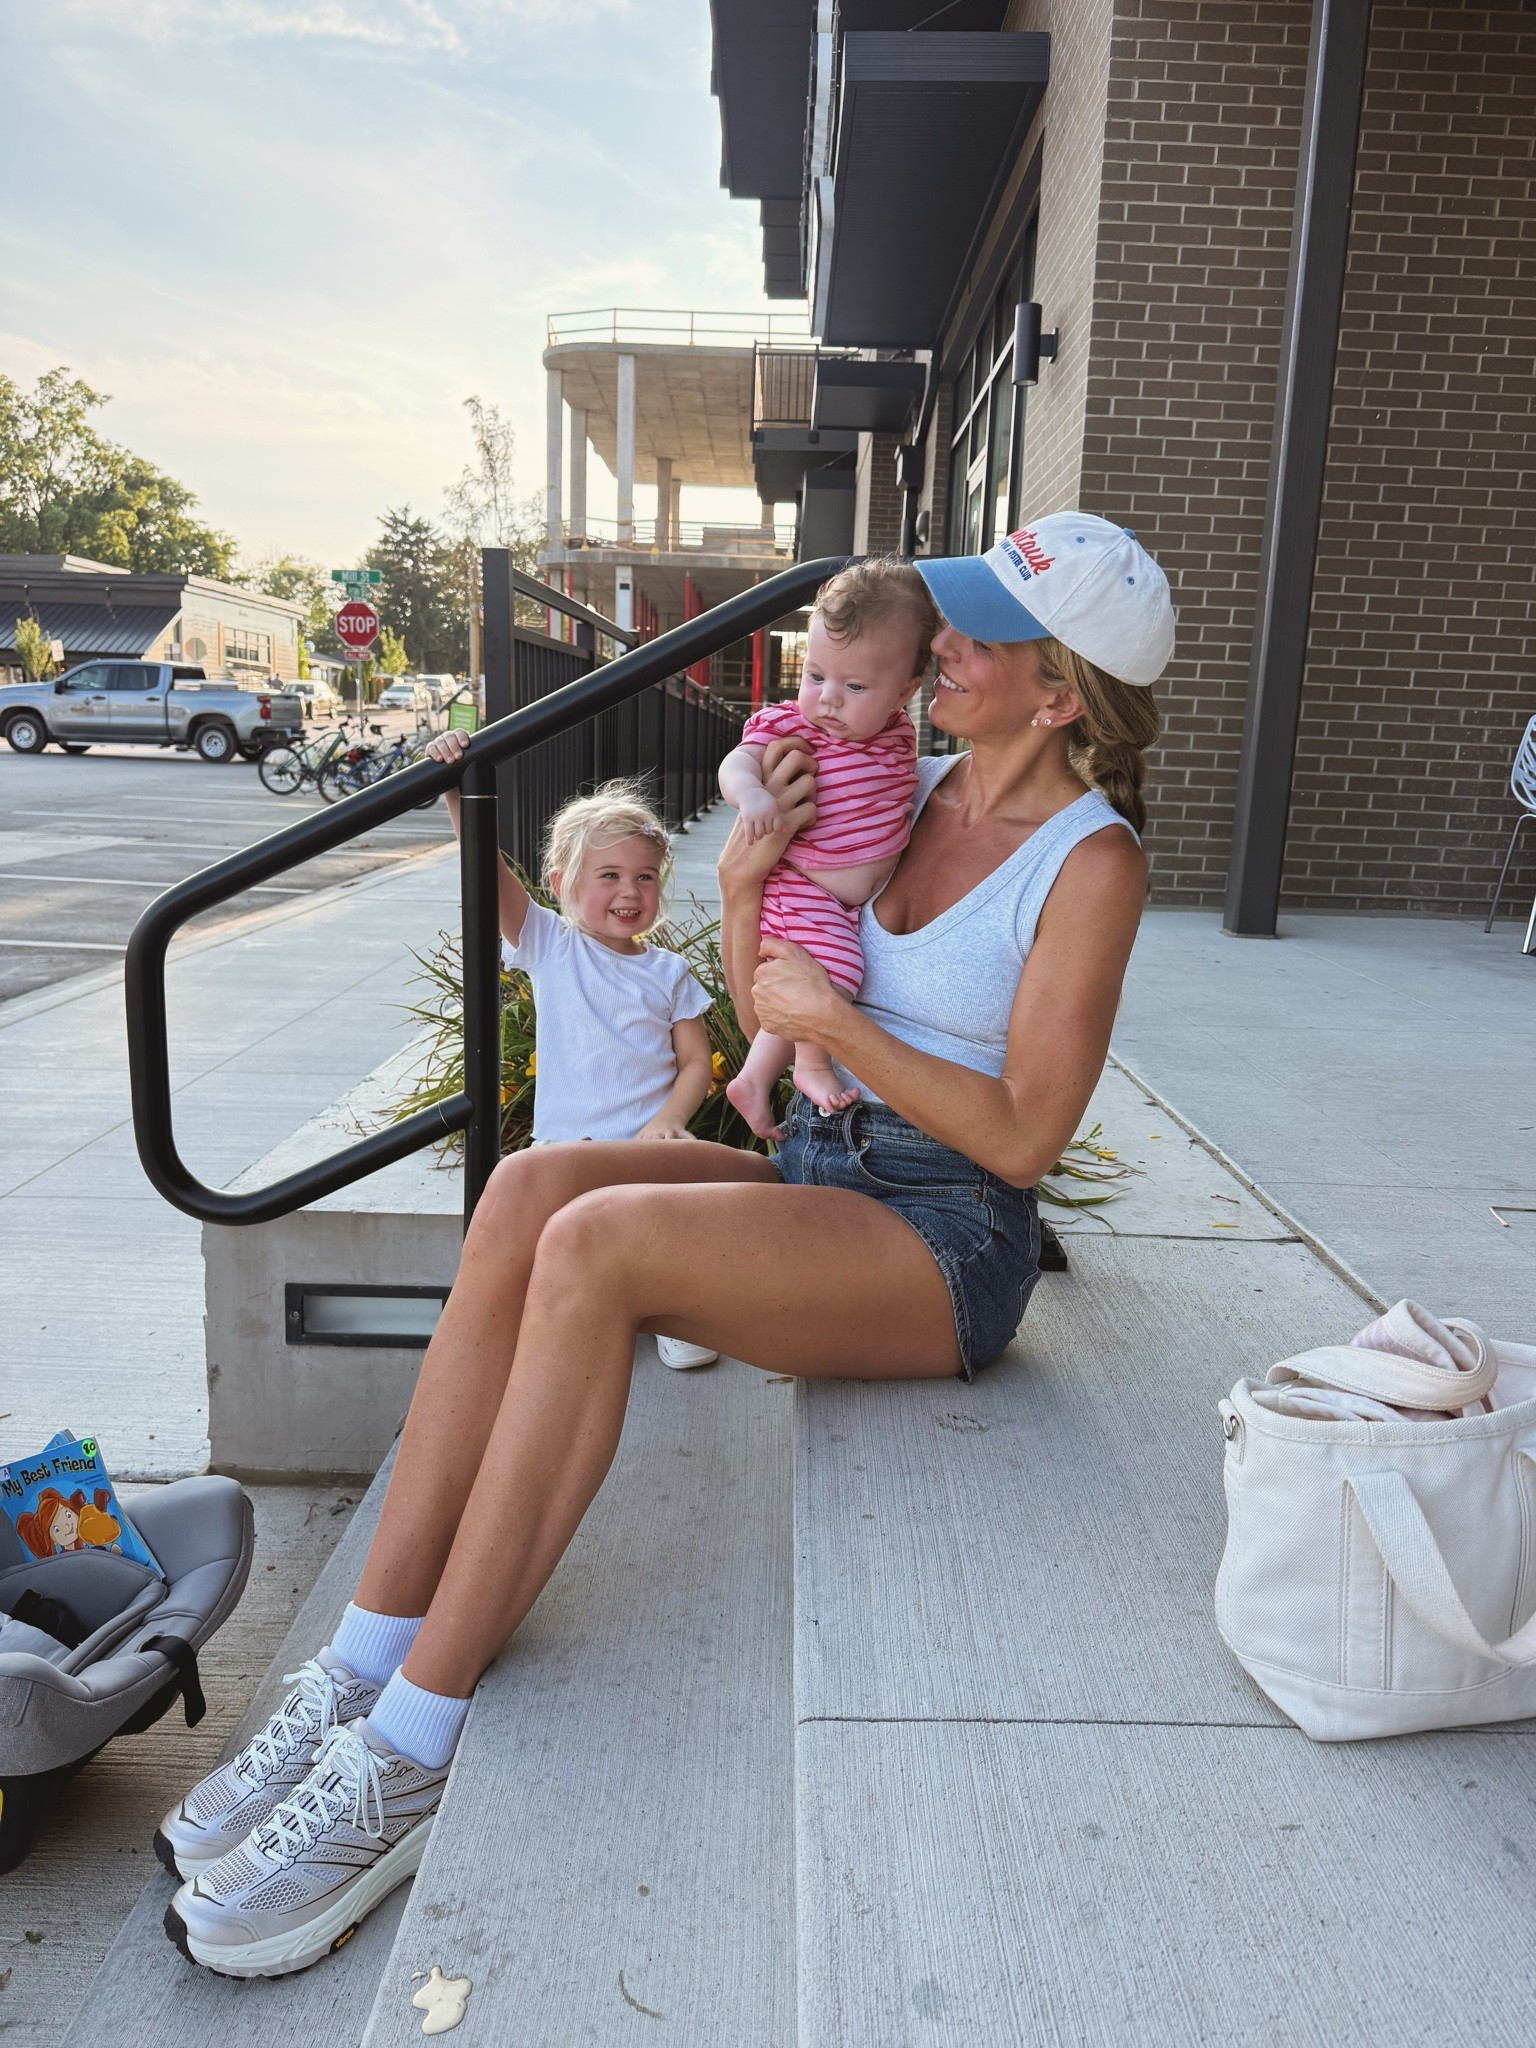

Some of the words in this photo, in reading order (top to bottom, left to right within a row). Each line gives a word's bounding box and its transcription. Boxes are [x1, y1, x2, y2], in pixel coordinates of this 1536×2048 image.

[341, 571, 358, 582] Mill
[1018, 565, 1032, 581] CLUB
[338, 616, 376, 634] STOP
[1, 1479, 24, 1498] My
[20, 1462, 51, 1487] Best
[52, 1456, 97, 1474] Friend
